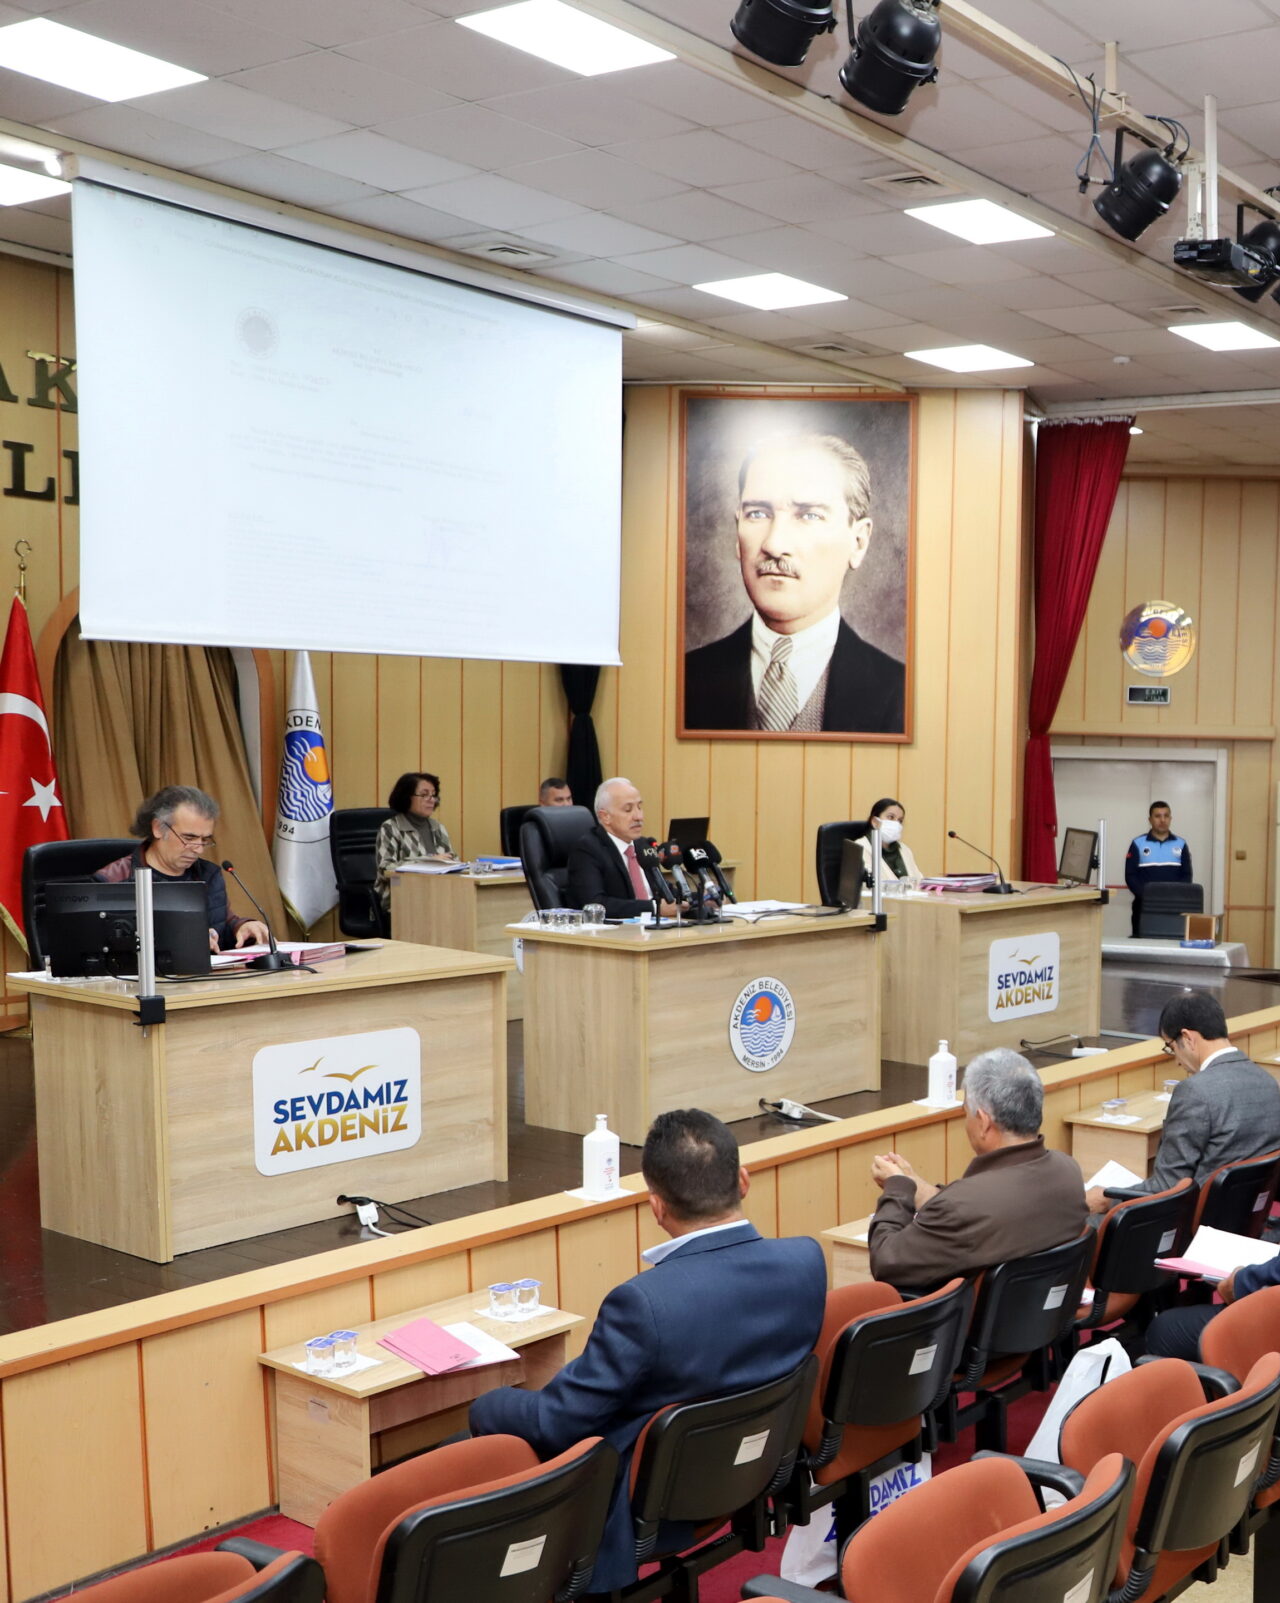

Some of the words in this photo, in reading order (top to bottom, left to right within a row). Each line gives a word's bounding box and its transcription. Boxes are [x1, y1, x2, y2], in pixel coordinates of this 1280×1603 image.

[997, 966, 1054, 990] SEVDAMIZ
[771, 1048, 784, 1063] 1994
[273, 1079, 409, 1125] SEVDAMIZ
[870, 1464, 922, 1508] DAMIZ
